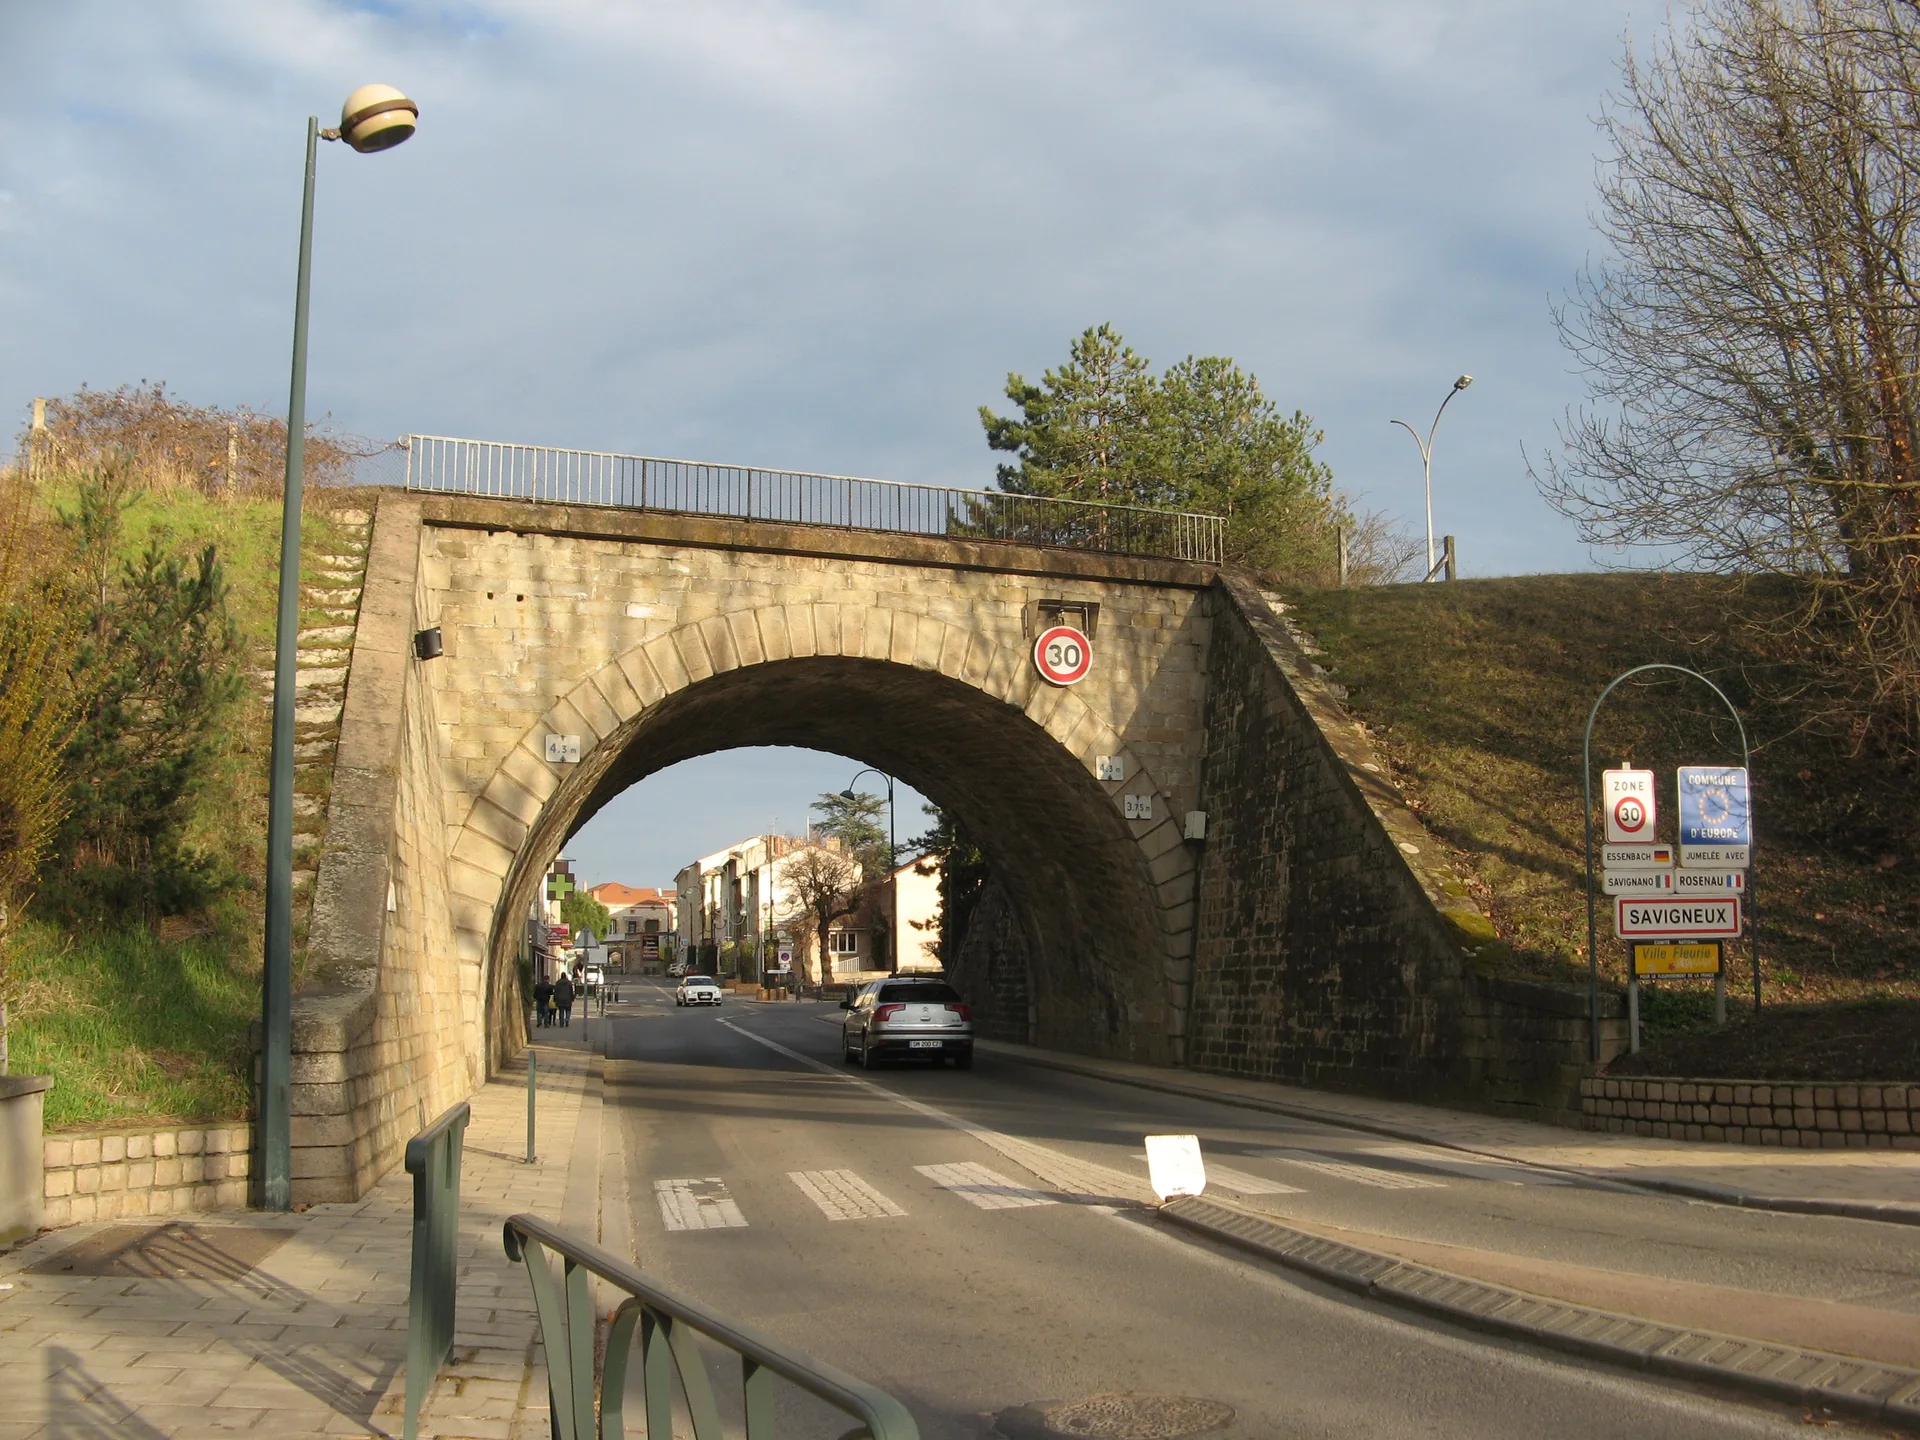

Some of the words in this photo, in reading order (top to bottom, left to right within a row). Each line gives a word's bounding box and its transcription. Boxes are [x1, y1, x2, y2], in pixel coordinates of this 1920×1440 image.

[1048, 644, 1080, 667] 30
[550, 743, 567, 754] 4.3
[1100, 763, 1114, 773] 4.3
[1688, 774, 1737, 786] COMMUNE
[1614, 781, 1644, 791] ZONE
[1126, 801, 1144, 812] 3.75
[1621, 807, 1640, 822] 30
[1606, 851, 1651, 861] ESSENBACH
[1686, 851, 1720, 860] JUMELÉE
[1725, 851, 1744, 860] AVEC
[1608, 877, 1654, 887] SAVIGNANO
[1679, 875, 1723, 886] ROSENAU
[1629, 908, 1727, 925] SAVIGNEUX
[1642, 947, 1667, 959] Ville
[1673, 946, 1711, 959] Fleurie
